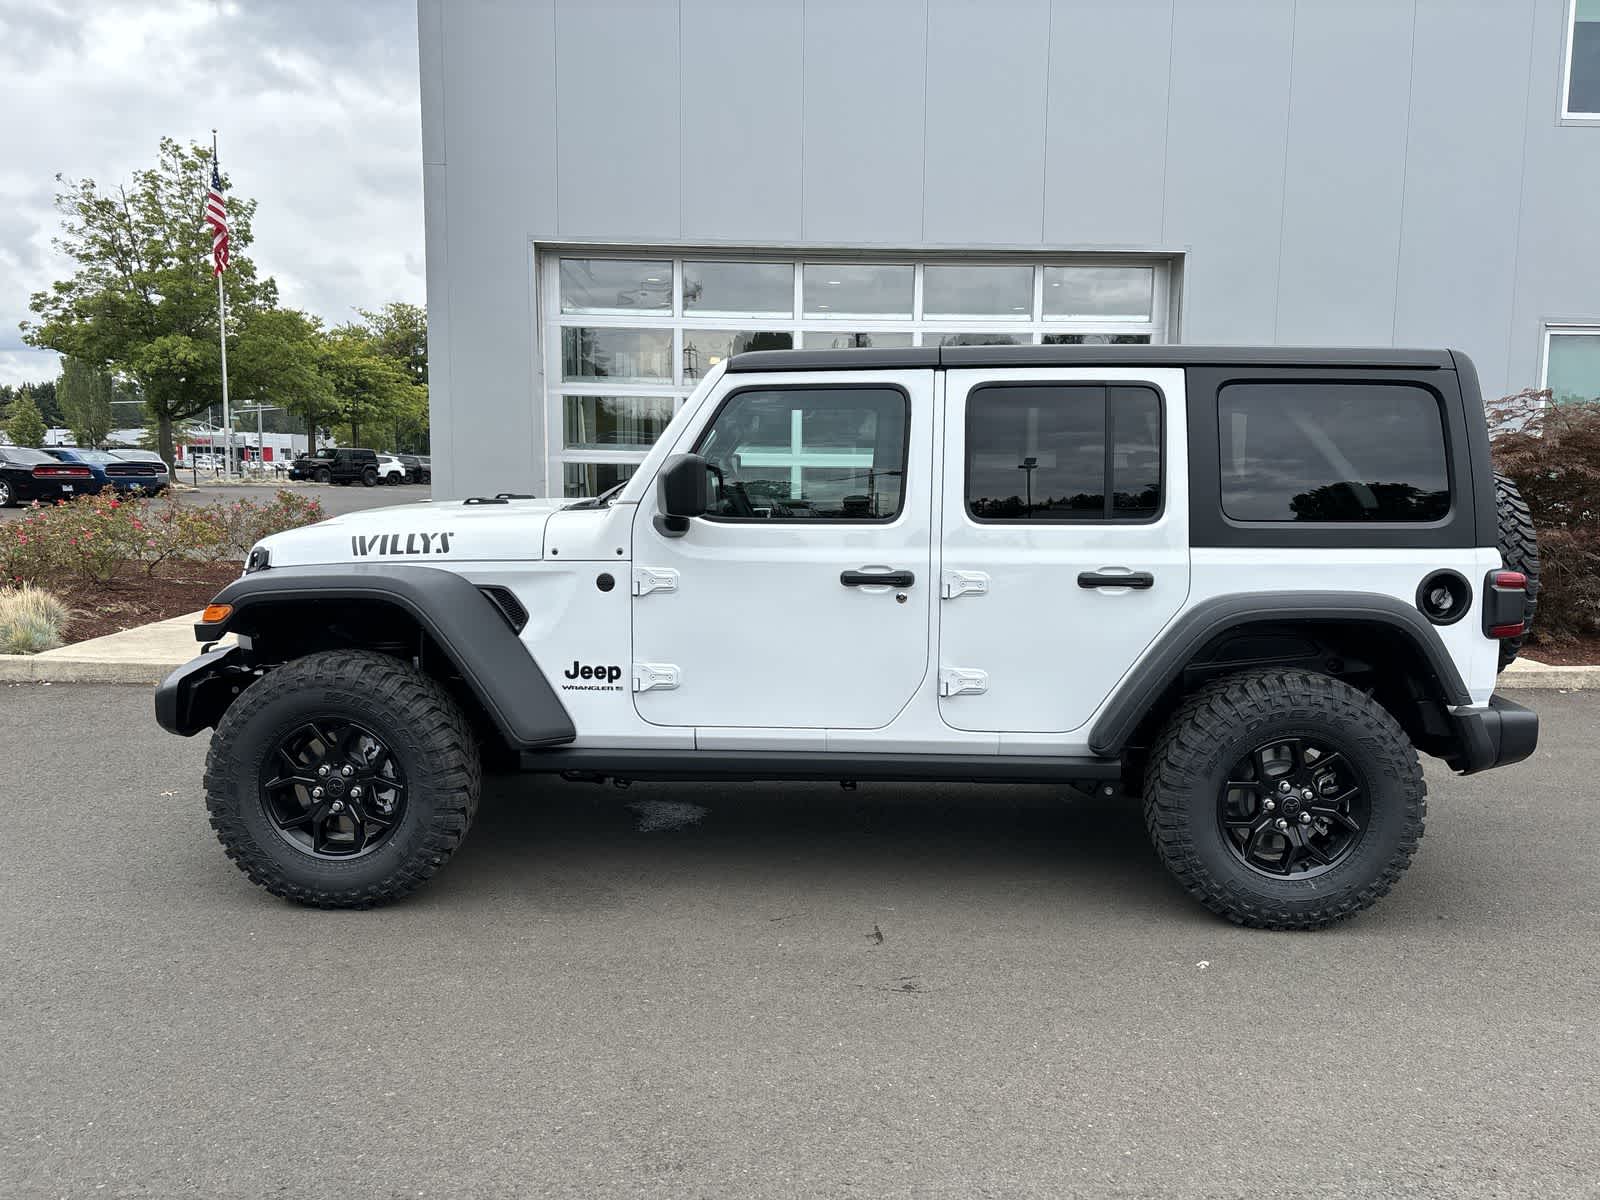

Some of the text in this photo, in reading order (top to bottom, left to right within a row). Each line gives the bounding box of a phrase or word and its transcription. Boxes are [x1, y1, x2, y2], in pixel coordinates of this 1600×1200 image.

[351, 532, 455, 556] WILLYS
[564, 660, 622, 684] Jeep
[561, 684, 614, 692] WRANGLER
